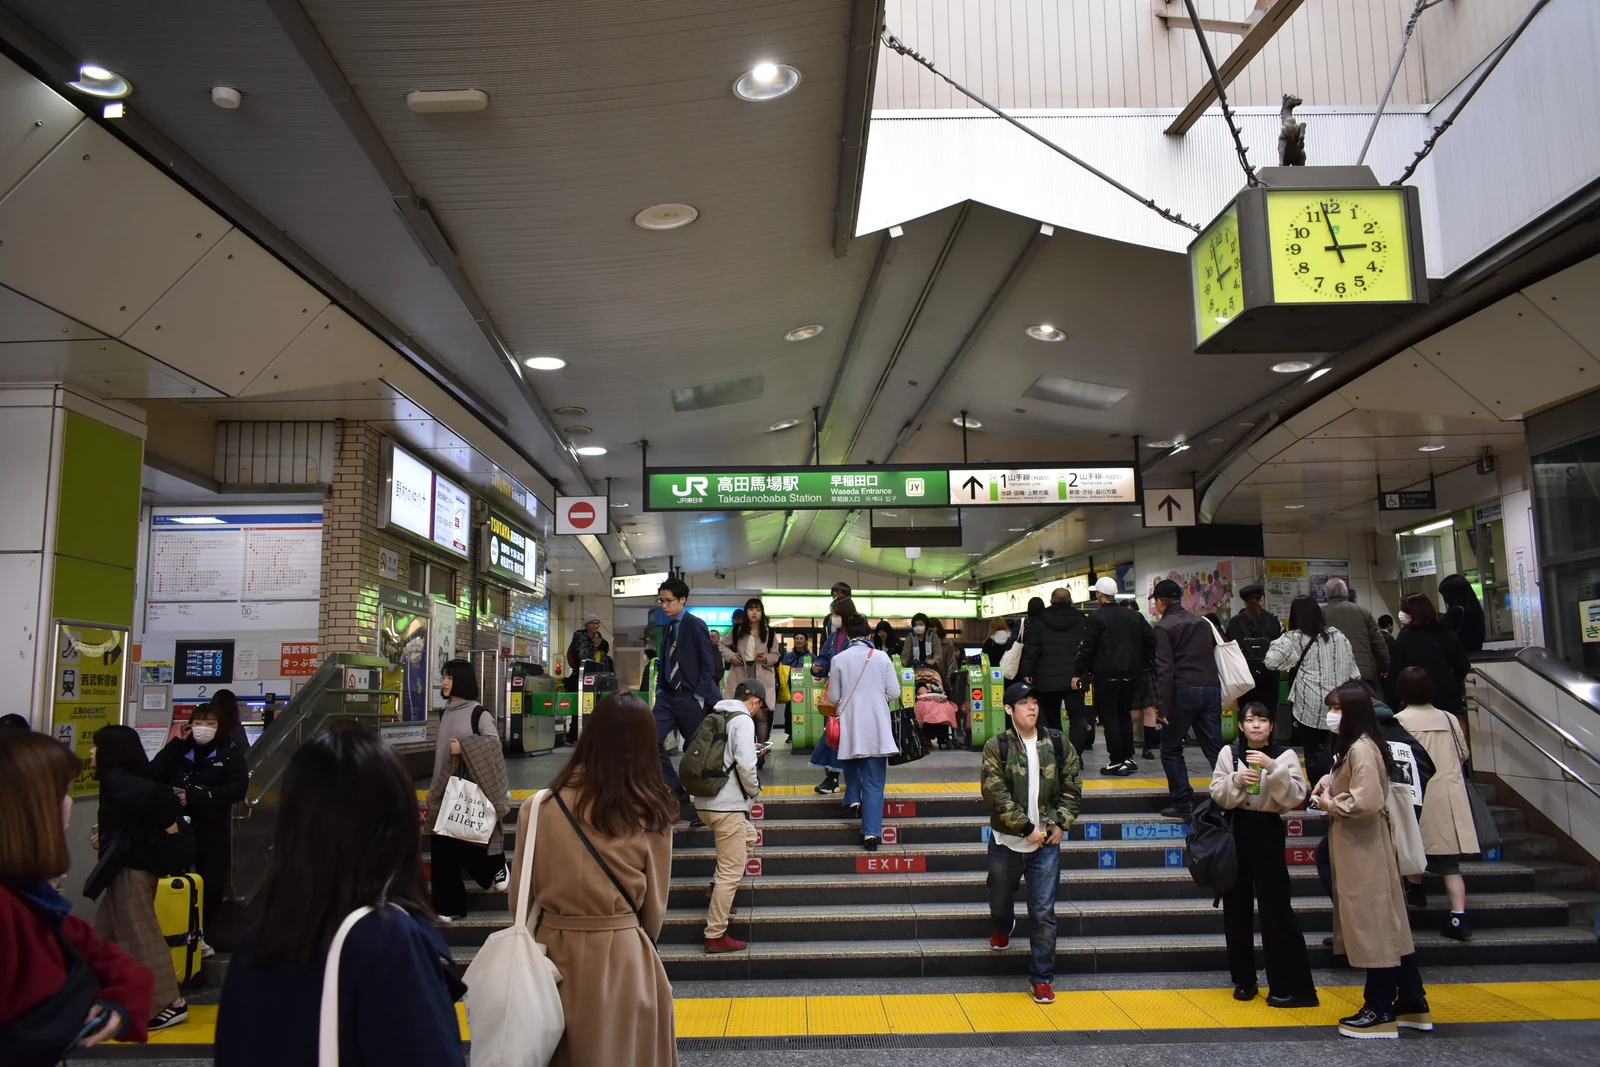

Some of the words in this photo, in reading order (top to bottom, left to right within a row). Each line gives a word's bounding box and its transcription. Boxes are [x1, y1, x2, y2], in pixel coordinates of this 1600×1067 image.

[1323, 202, 1341, 214] 12
[1350, 208, 1357, 219] 1
[1306, 211, 1321, 222] 11
[1293, 227, 1310, 239] 10
[1363, 223, 1374, 234] 2
[1230, 241, 1235, 254] 2
[1290, 244, 1301, 255] 9
[1371, 241, 1382, 252] 3
[1298, 262, 1310, 274] 8
[1366, 261, 1378, 272] 4
[1233, 279, 1240, 289] 4
[1314, 277, 1324, 288] 7
[1354, 275, 1365, 287] 5
[1205, 284, 1211, 295] 9
[1335, 282, 1346, 294] 6
[717, 476, 799, 492] 高田馬場駅
[830, 475, 878, 487] 早稲田口
[1000, 474, 1006, 488] 1
[1069, 472, 1078, 487] 2
[672, 476, 708, 496] JR
[910, 483, 920, 491] JY
[718, 494, 786, 503] Takadanobaba
[789, 493, 822, 502] Station
[490, 516, 511, 542] TSUTAYA
[81, 673, 117, 686] 西武新宿線
[198, 685, 207, 698] 2
[257, 682, 264, 694] 1
[447, 813, 484, 831] allery
[868, 858, 914, 870] EXIT
